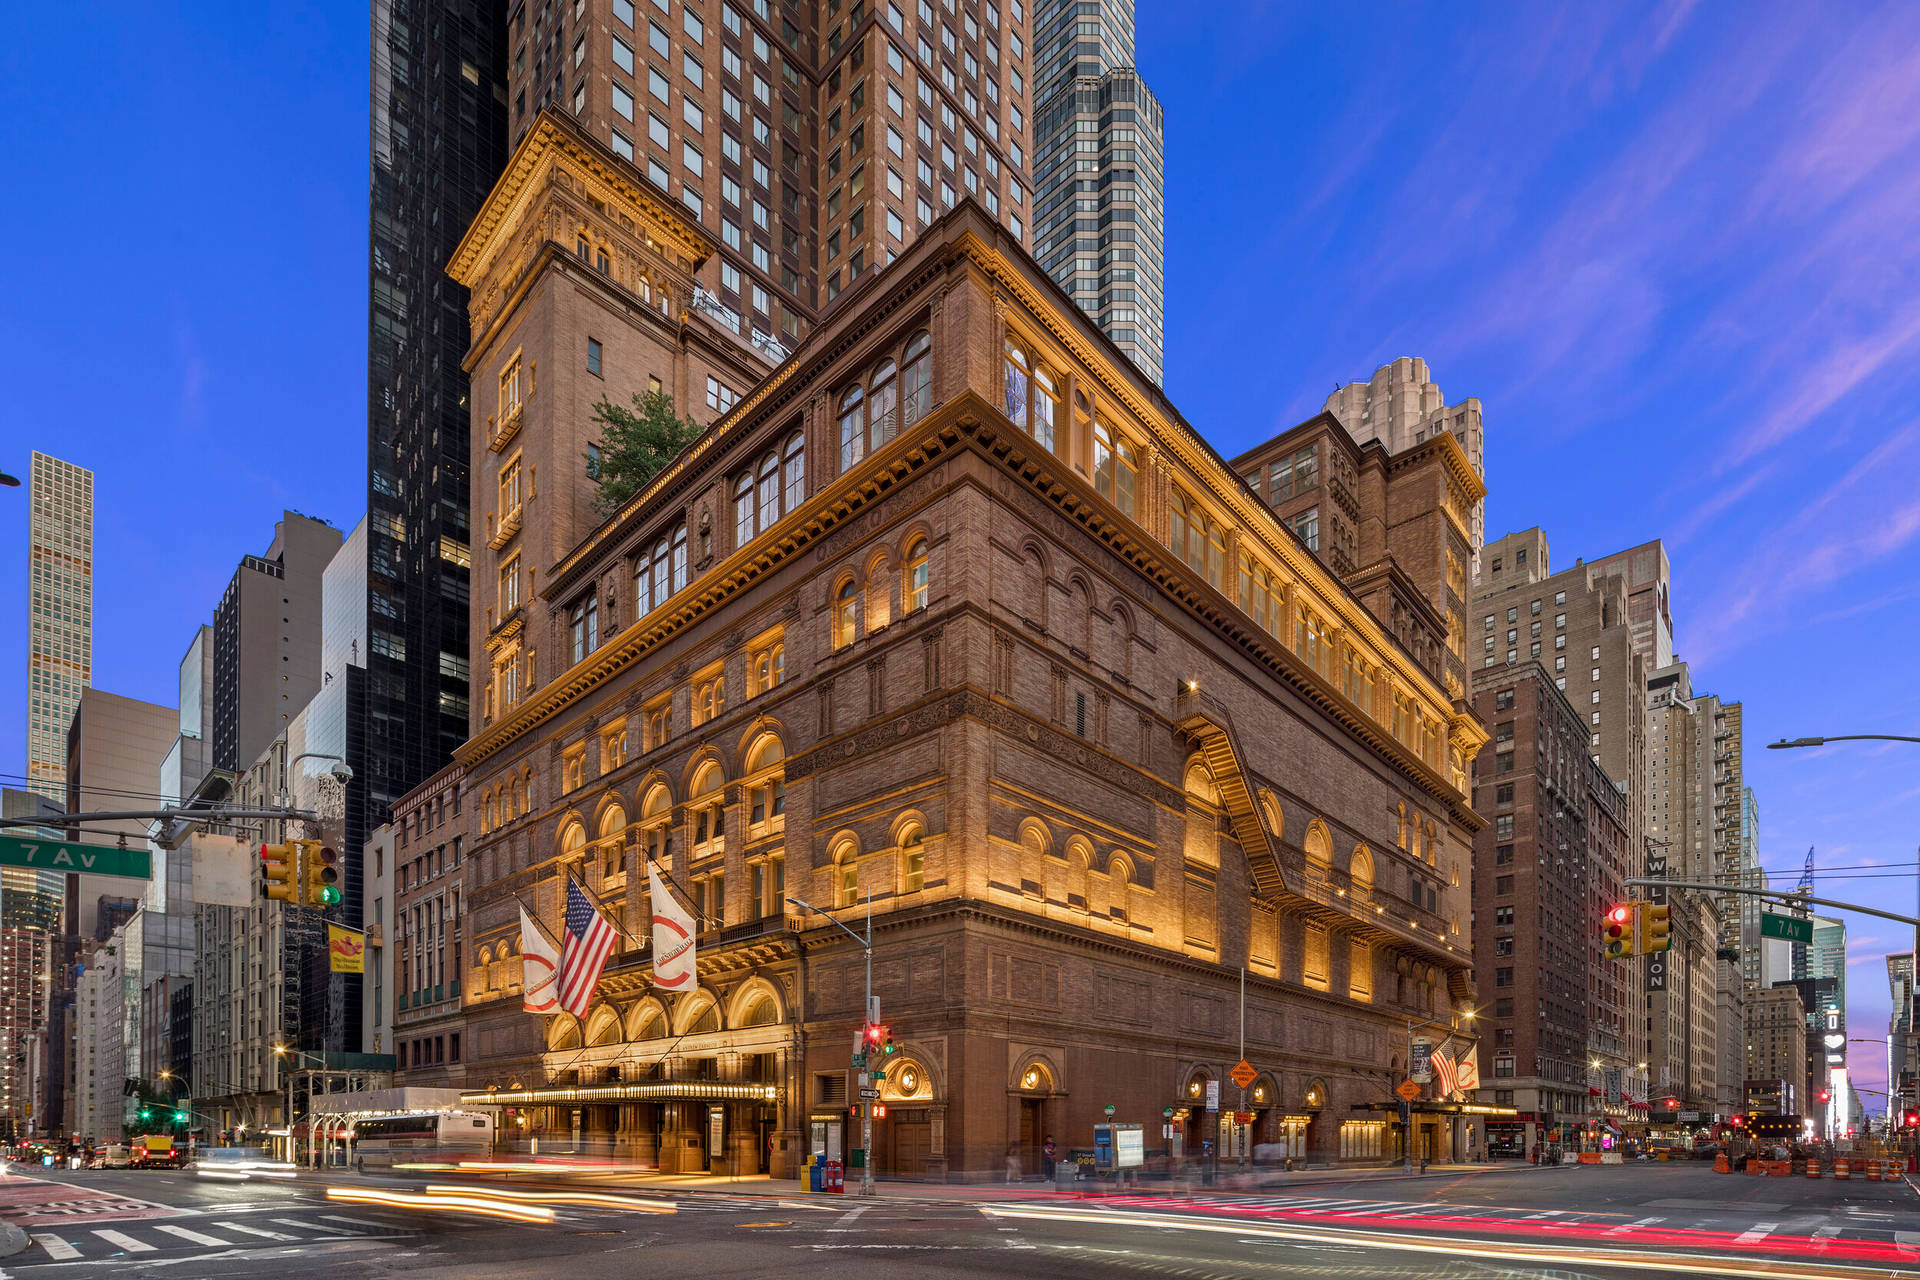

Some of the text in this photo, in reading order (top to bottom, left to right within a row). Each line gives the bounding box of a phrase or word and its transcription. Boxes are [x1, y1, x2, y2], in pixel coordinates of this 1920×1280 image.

[21, 844, 96, 867] 7 Av
[1778, 920, 1800, 937] 7 Av
